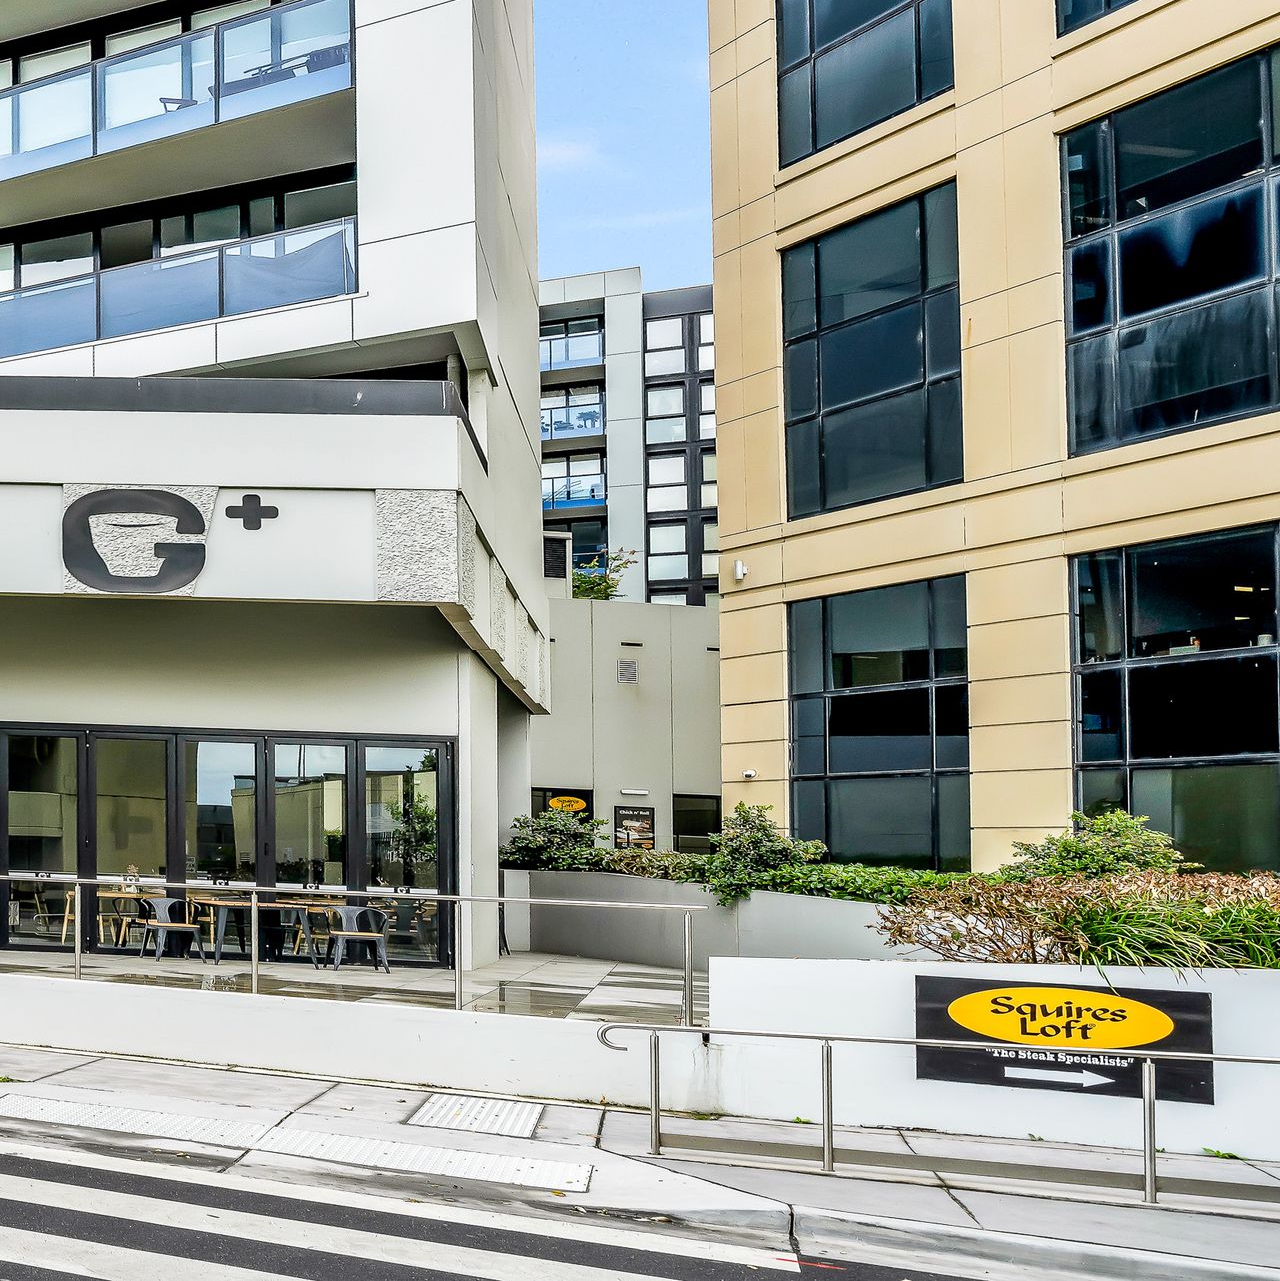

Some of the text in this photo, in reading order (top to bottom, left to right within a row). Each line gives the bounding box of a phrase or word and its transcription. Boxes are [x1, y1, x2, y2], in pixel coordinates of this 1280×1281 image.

[990, 996, 1128, 1023] Squires
[1017, 1049, 1056, 1062] Steak
[1056, 1051, 1134, 1068] Specialists"
